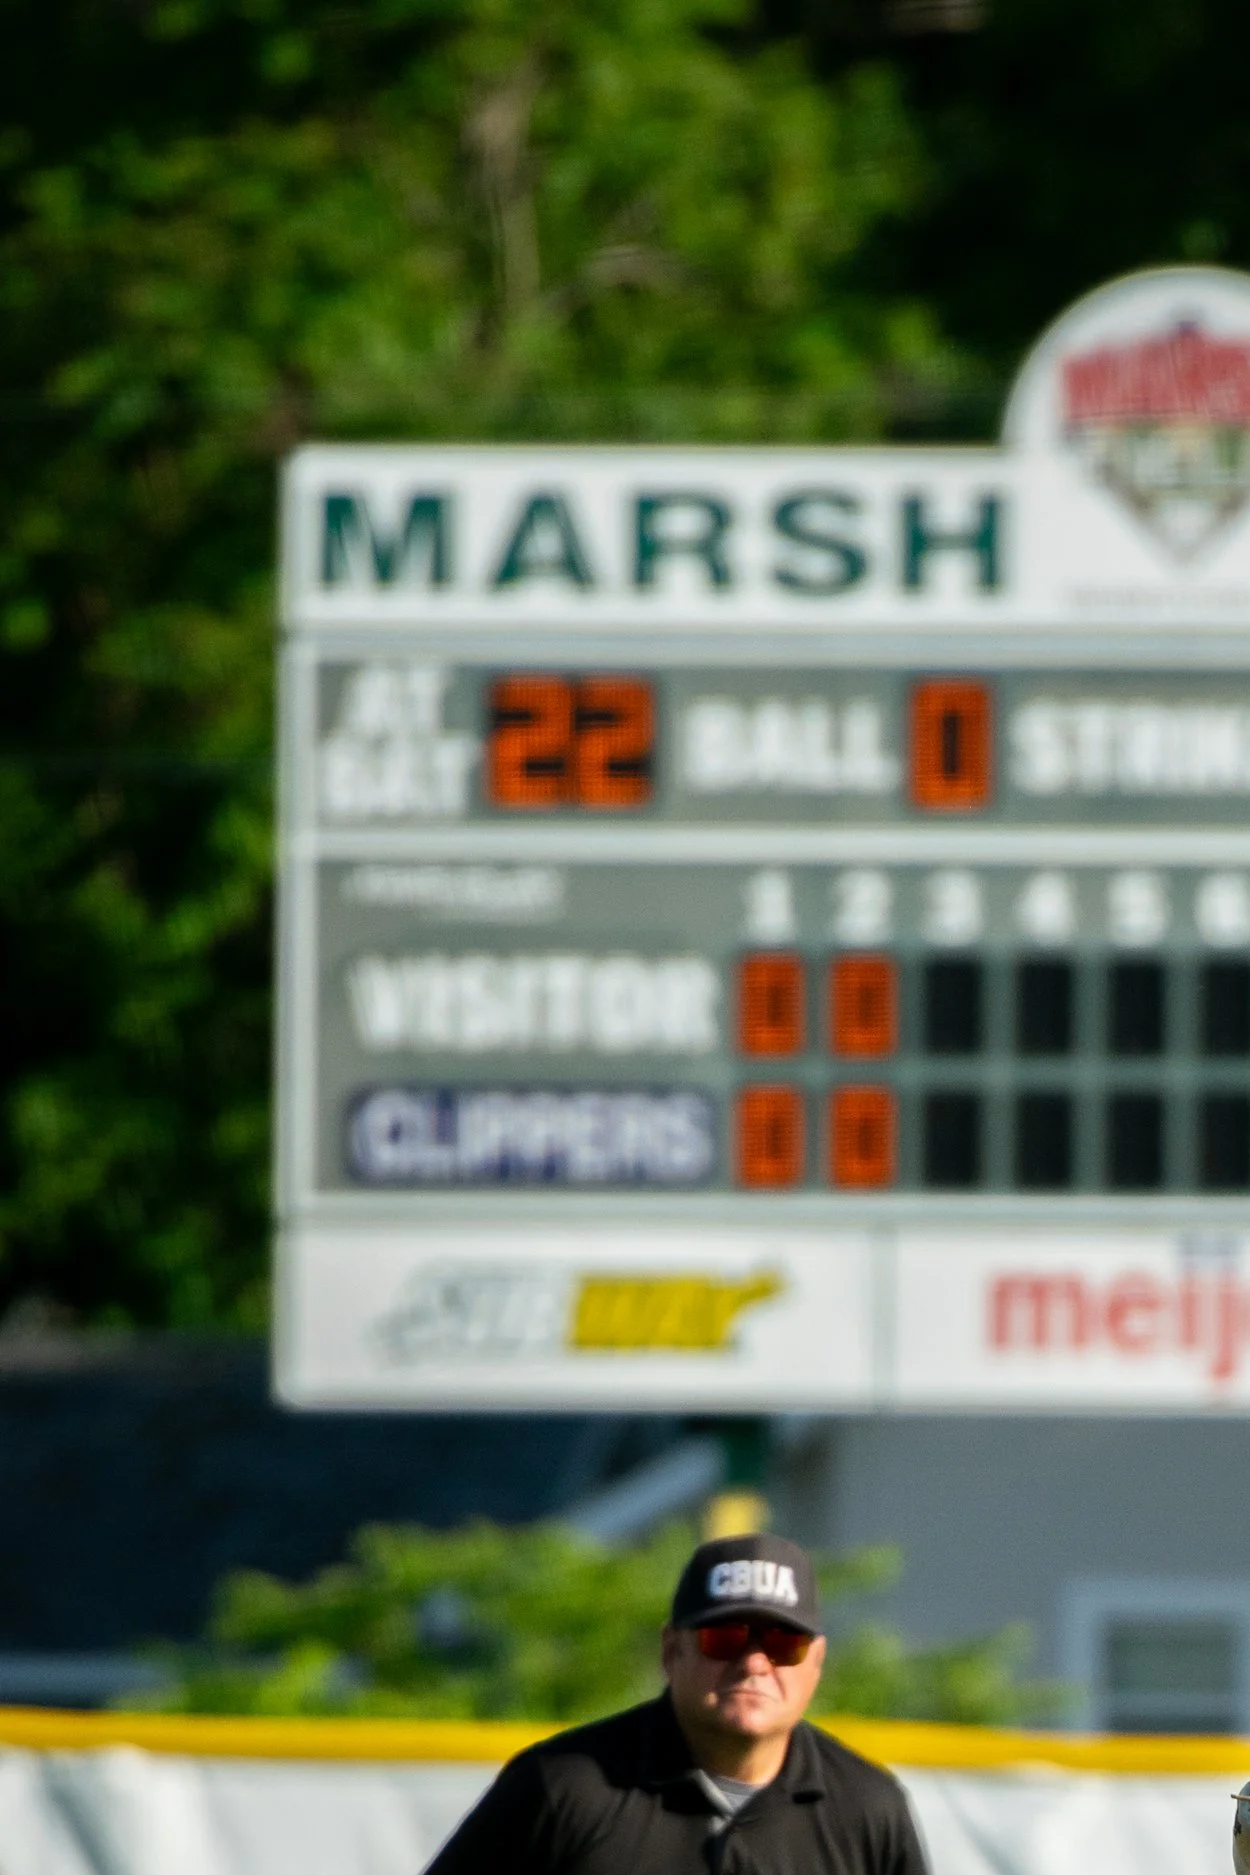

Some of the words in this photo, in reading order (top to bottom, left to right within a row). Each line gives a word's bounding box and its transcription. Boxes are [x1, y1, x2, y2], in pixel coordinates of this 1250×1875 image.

[320, 487, 1008, 594] MARSH
[350, 664, 445, 732] AT
[486, 675, 656, 810] 22
[686, 696, 896, 792] BALL
[910, 676, 993, 813] 0
[746, 872, 796, 946] 1
[834, 870, 894, 947] 2
[923, 870, 983, 947] 3
[1017, 870, 1076, 948] 4
[1107, 870, 1168, 948] 5
[350, 952, 718, 1052] VISITOR
[739, 952, 804, 1060] 0
[830, 952, 896, 1060] 0
[356, 1090, 714, 1178] CLIPPERS
[738, 1084, 804, 1190] 0
[830, 1084, 896, 1190] 0
